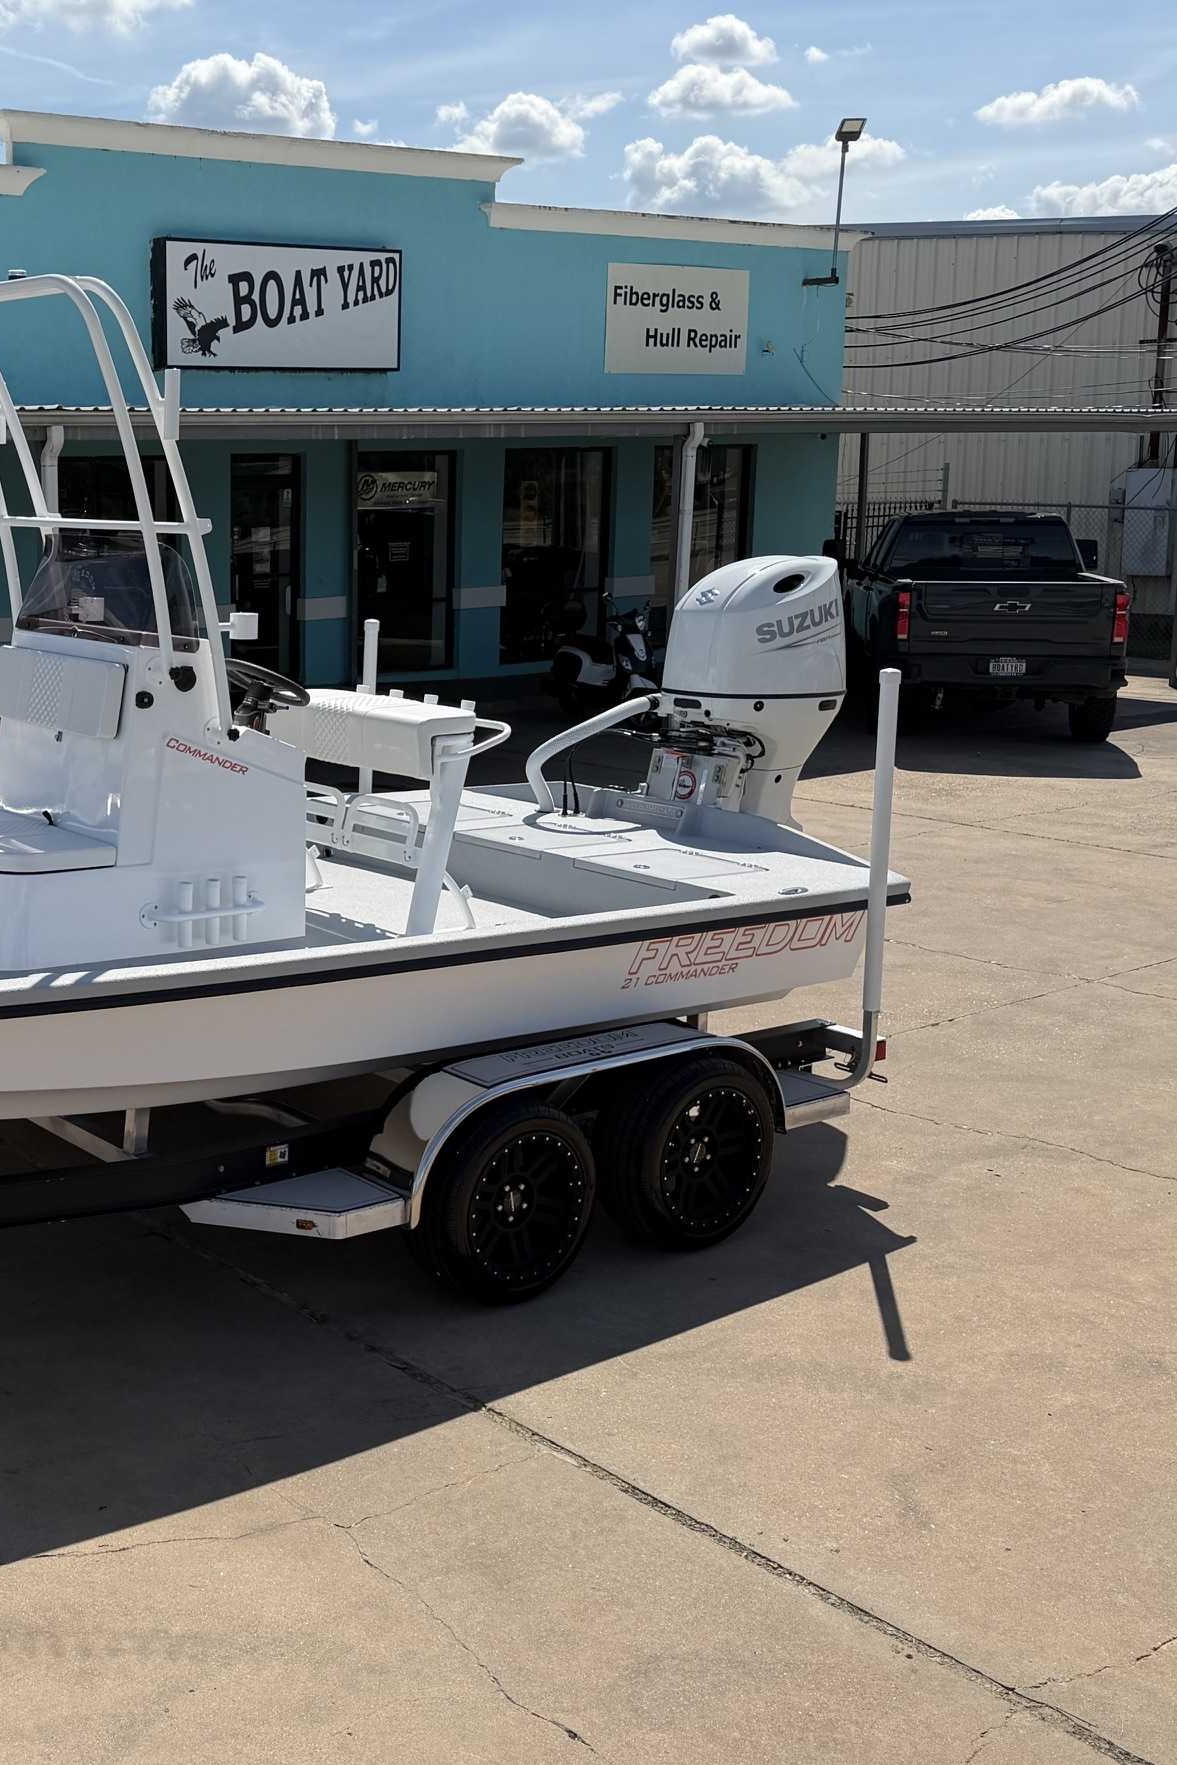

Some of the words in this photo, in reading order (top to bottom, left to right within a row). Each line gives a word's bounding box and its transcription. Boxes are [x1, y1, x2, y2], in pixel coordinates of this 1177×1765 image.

[183, 249, 217, 289] The
[228, 265, 328, 334] BOAT
[336, 256, 398, 311] YARD
[613, 285, 704, 313] Fiberglass
[709, 291, 721, 311] &
[645, 328, 681, 348] Hull
[686, 329, 741, 353] Repair
[379, 481, 435, 492] MERCURY
[755, 598, 839, 644] SUZUKI
[166, 737, 249, 775] COMMANDER
[628, 910, 863, 975] FREEDOM
[621, 977, 640, 990] 21
[644, 962, 739, 986] COMMANDER
